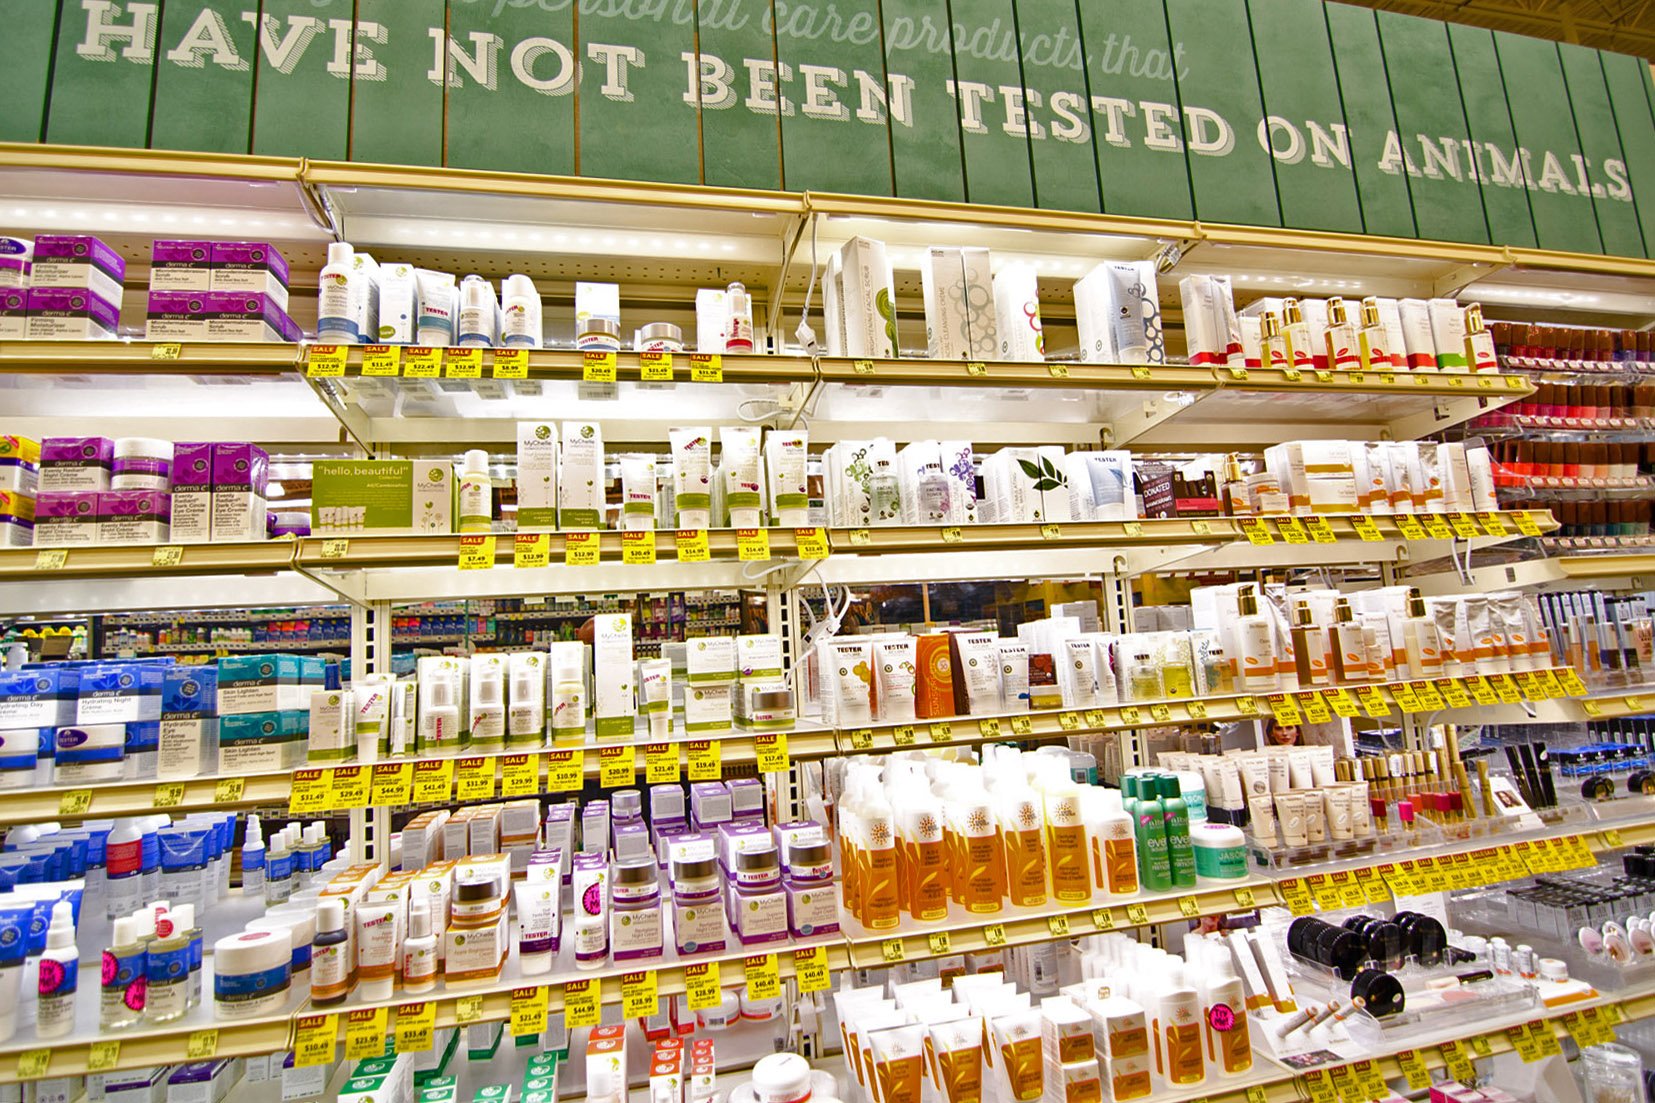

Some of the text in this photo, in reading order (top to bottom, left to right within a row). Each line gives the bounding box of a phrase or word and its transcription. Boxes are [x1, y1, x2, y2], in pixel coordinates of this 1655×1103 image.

[761, 1, 879, 45] care
[879, 12, 1093, 72] products
[1101, 32, 1190, 82] that
[76, 0, 1635, 202] HAVE NOT BEEN TESTED ON ANIMALS
[1144, 482, 1170, 498] DONATED
[568, 532, 588, 540] SALE
[624, 531, 644, 539] SALE
[676, 530, 696, 538] SALE
[738, 529, 757, 537] SALE
[516, 534, 537, 542] SALE
[360, 692, 379, 715] TESTER
[163, 712, 190, 720] derma
[647, 744, 668, 752] SALE
[690, 741, 708, 750] SALE
[550, 752, 571, 760] SALE
[602, 747, 622, 756] SALE
[460, 758, 482, 768] SALE
[504, 756, 526, 765] SALE
[376, 764, 399, 773] SALE
[418, 762, 441, 770] SALE
[295, 771, 319, 780] SALE
[336, 767, 358, 776] SALE
[381, 786, 405, 794] $44.99
[1356, 868, 1371, 876] SALE
[1379, 864, 1393, 873] SALE
[1309, 874, 1324, 883] SALE
[1332, 872, 1348, 881] SALE
[1282, 880, 1297, 889] SALE
[794, 950, 815, 958] SALE
[746, 957, 766, 966] SALE
[686, 966, 707, 975] SALE
[624, 974, 644, 982] SALE
[566, 982, 588, 991] SALE
[514, 988, 535, 998] SALE
[399, 1005, 423, 1014] SALE
[350, 1011, 374, 1020] SALE
[1214, 1010, 1228, 1019] Try
[300, 1017, 325, 1027] SALE
